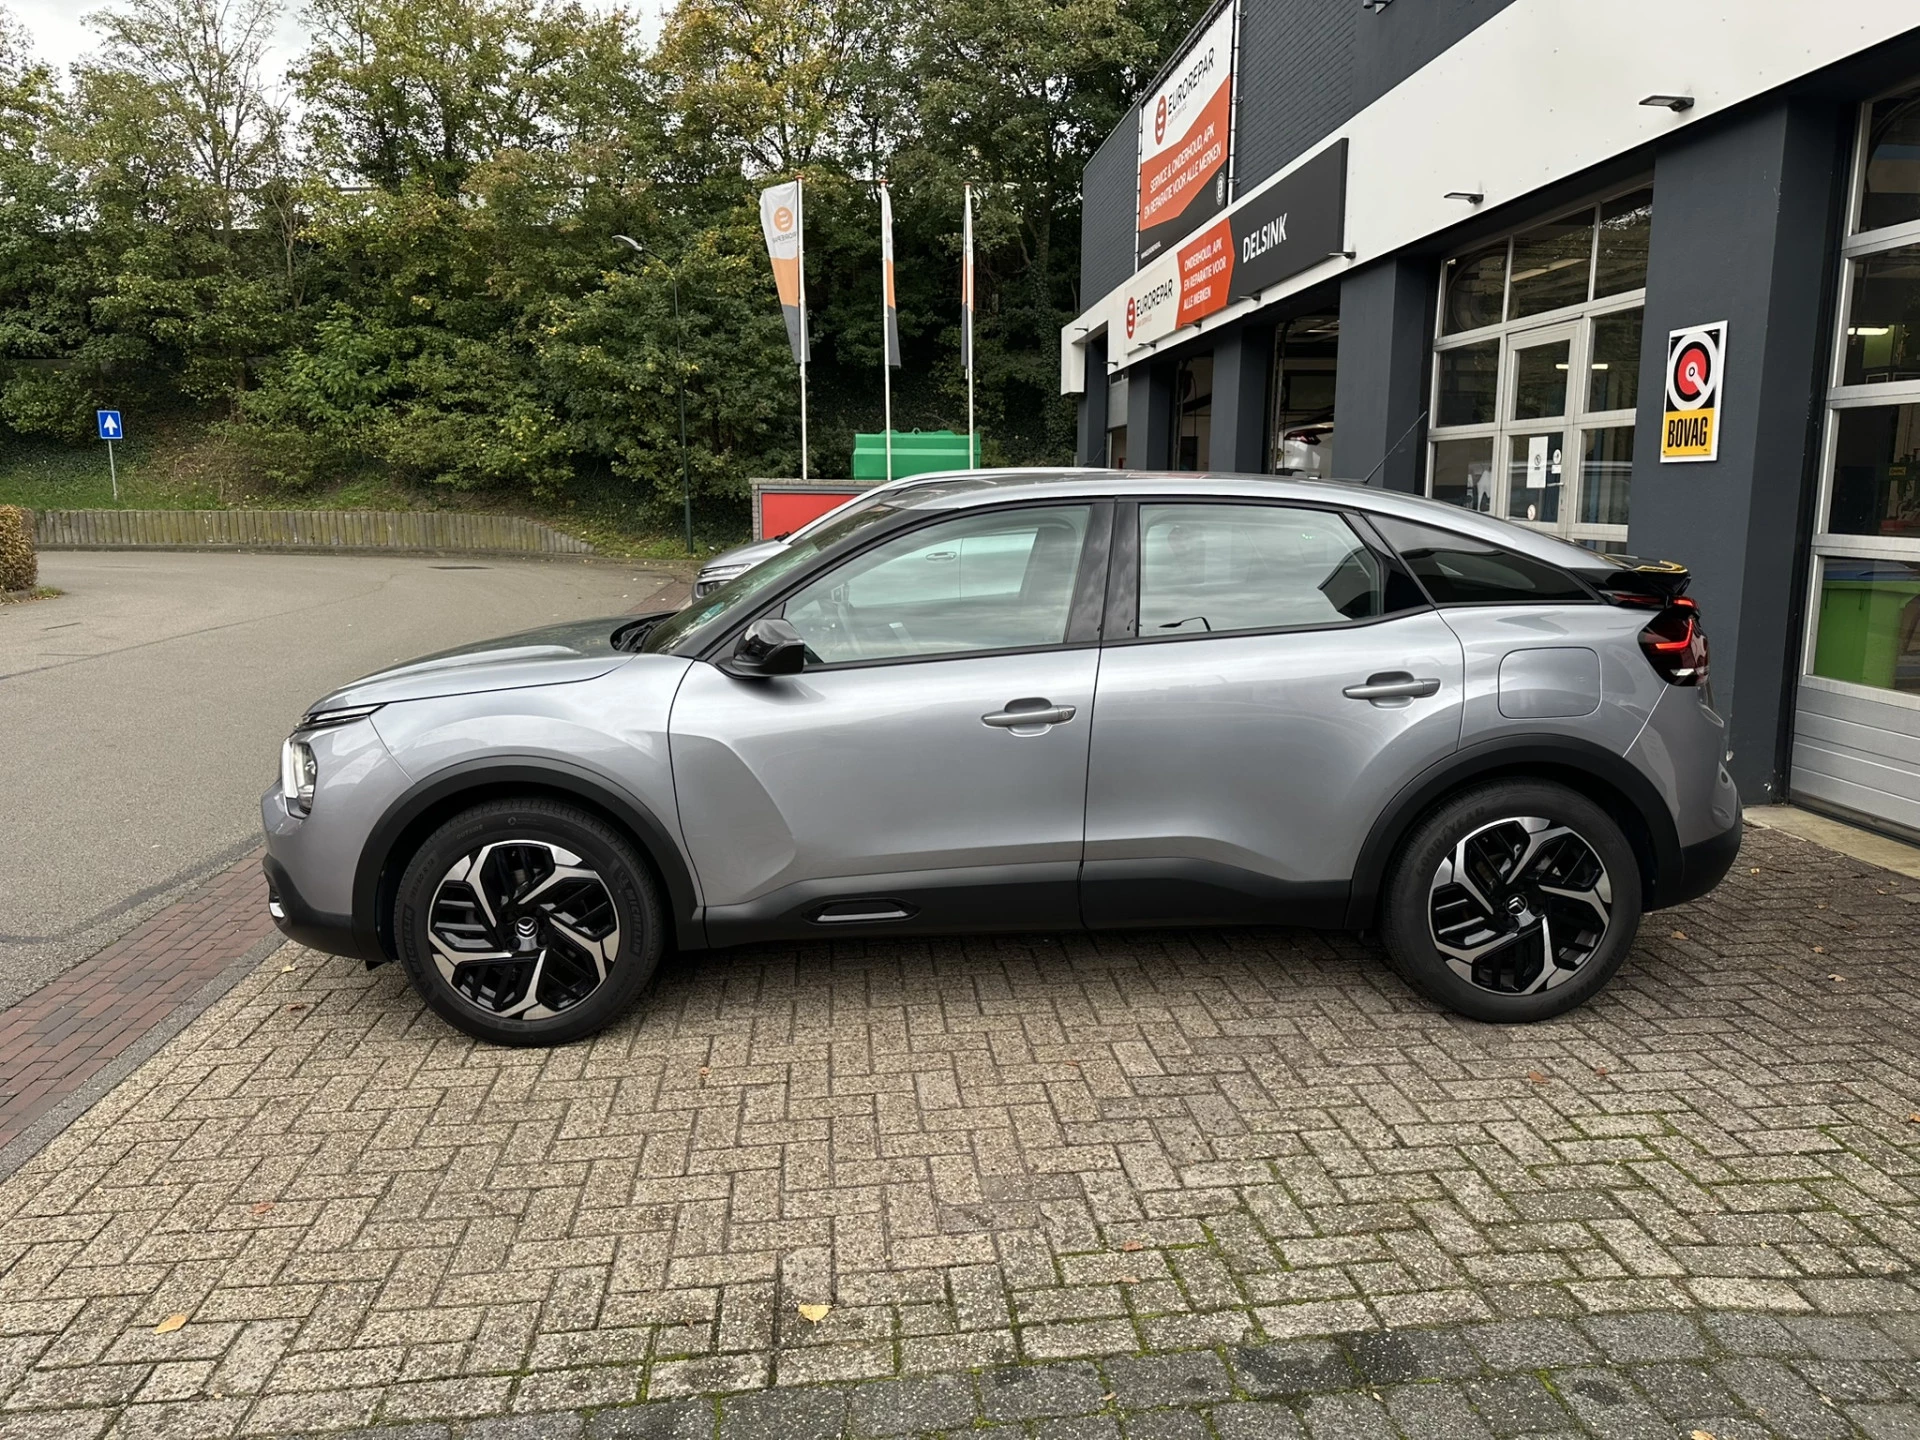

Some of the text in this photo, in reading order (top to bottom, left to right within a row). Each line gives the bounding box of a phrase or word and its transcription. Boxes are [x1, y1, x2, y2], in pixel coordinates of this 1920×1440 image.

[1168, 47, 1214, 115] EUROREPAR
[1149, 166, 1167, 194] SERVICE
[1203, 122, 1215, 145] APK
[1173, 174, 1187, 196] VOOR
[1187, 161, 1199, 184] ALLE
[1199, 141, 1221, 172] MERKEN
[1212, 237, 1223, 256] APK
[1243, 213, 1288, 263] DELSINK
[1212, 256, 1227, 276] VOOR
[1136, 279, 1173, 317] EUROREPAR
[1183, 286, 1212, 311] ALLE MERKEN
[1667, 416, 1708, 448] BOVAG
